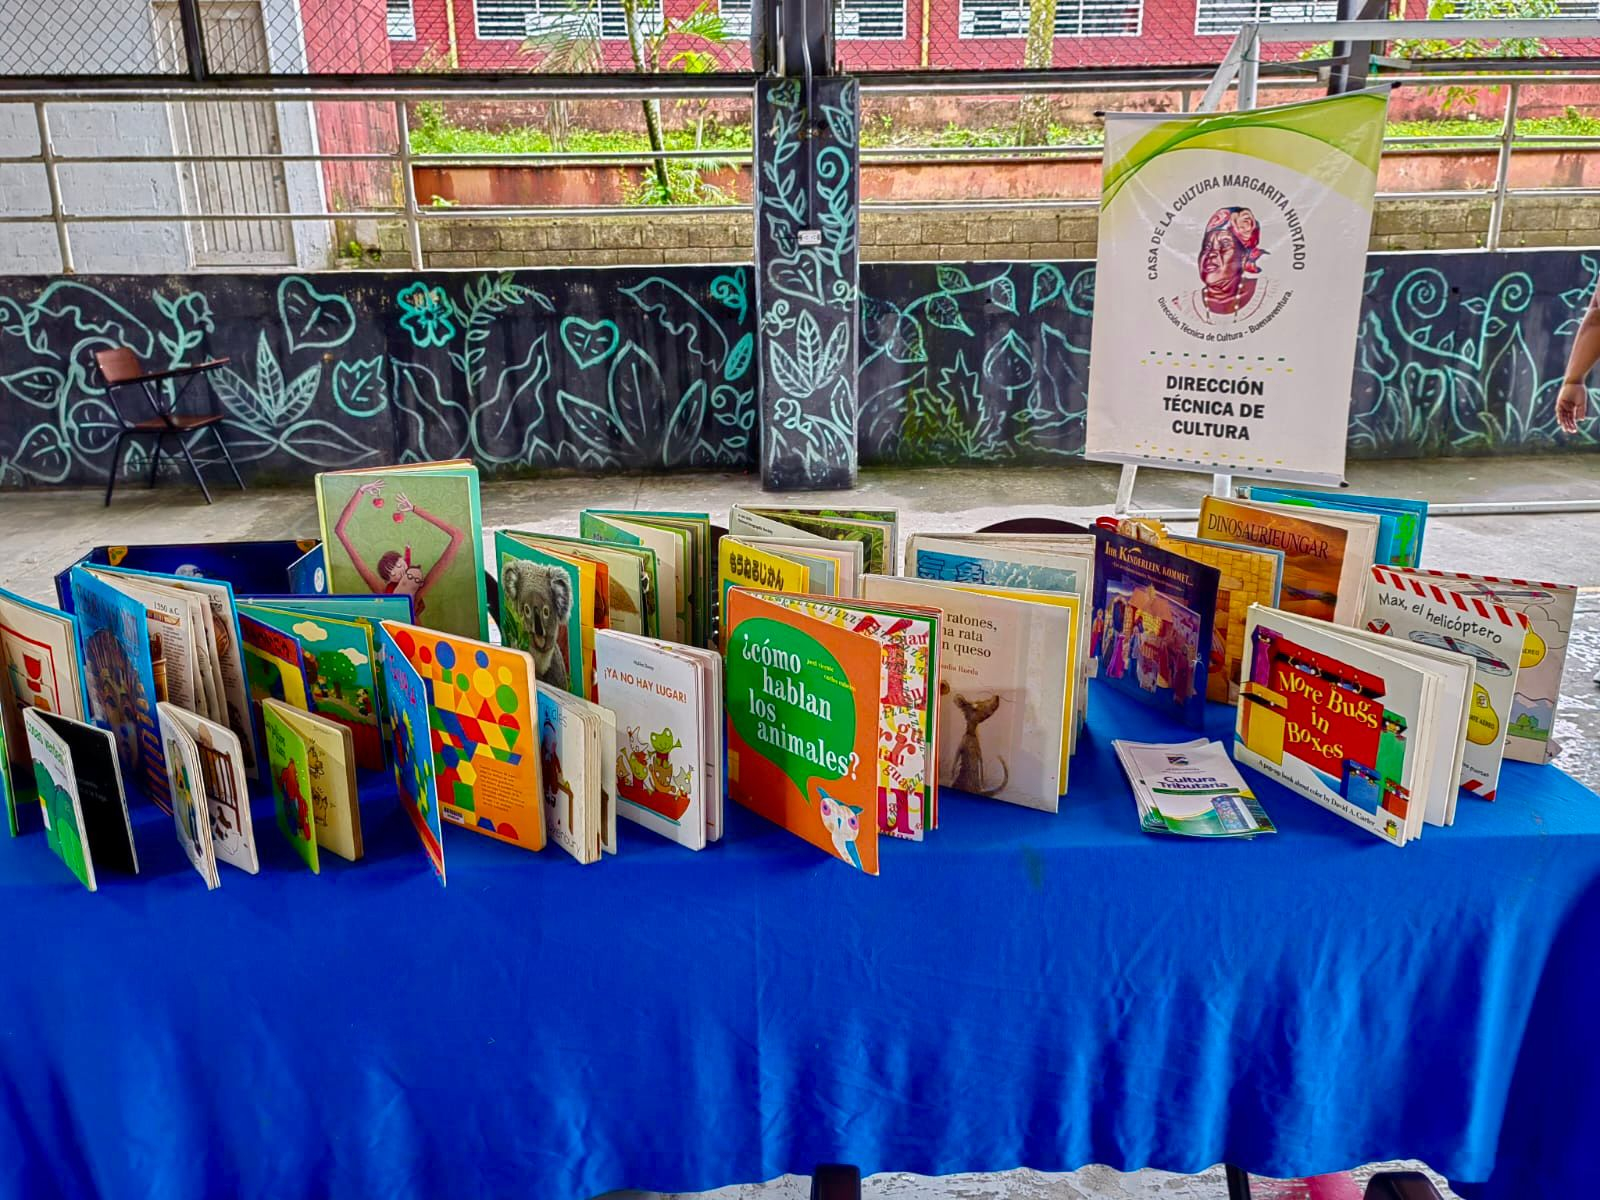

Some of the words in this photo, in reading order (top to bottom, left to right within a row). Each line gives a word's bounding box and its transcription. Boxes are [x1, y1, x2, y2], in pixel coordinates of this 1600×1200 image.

[1148, 246, 1158, 280] CASA
[1153, 227, 1165, 244] DE
[1160, 211, 1176, 227] LA
[1173, 177, 1220, 212] CULTURA
[1223, 175, 1290, 211] MARGARITA
[1284, 208, 1306, 270] HURTADO
[1158, 297, 1181, 327] Dirección
[1180, 322, 1205, 340] Técnica
[1206, 333, 1215, 341] de
[1216, 332, 1244, 342] Cultura
[1166, 375, 1264, 396] DIRECCIÓN
[1163, 394, 1234, 416] TÉCNICA
[1239, 404, 1265, 418] DE
[1172, 420, 1250, 440] CULTURA
[1208, 513, 1329, 559] DINOSAURIEUNGAR
[947, 612, 998, 631] ratones,
[959, 628, 983, 642] rata
[1378, 593, 1408, 610] Max,
[1412, 604, 1425, 615] el
[1426, 608, 1503, 644] helicóptero
[742, 633, 802, 674] ¿cómo
[953, 642, 992, 658] queso
[604, 667, 618, 680] ¡YA
[620, 672, 634, 685] NO
[636, 677, 654, 692] HAY
[655, 683, 687, 704] LUGAR!
[763, 667, 832, 722] hablan
[1278, 671, 1323, 705] More
[1326, 689, 1378, 729] Bugs
[749, 688, 777, 722] los
[1311, 705, 1330, 735] in
[758, 721, 860, 781] animales?
[1286, 721, 1344, 759] Boxes
[1157, 781, 1229, 789] Tributaria
[1331, 798, 1349, 813] David
